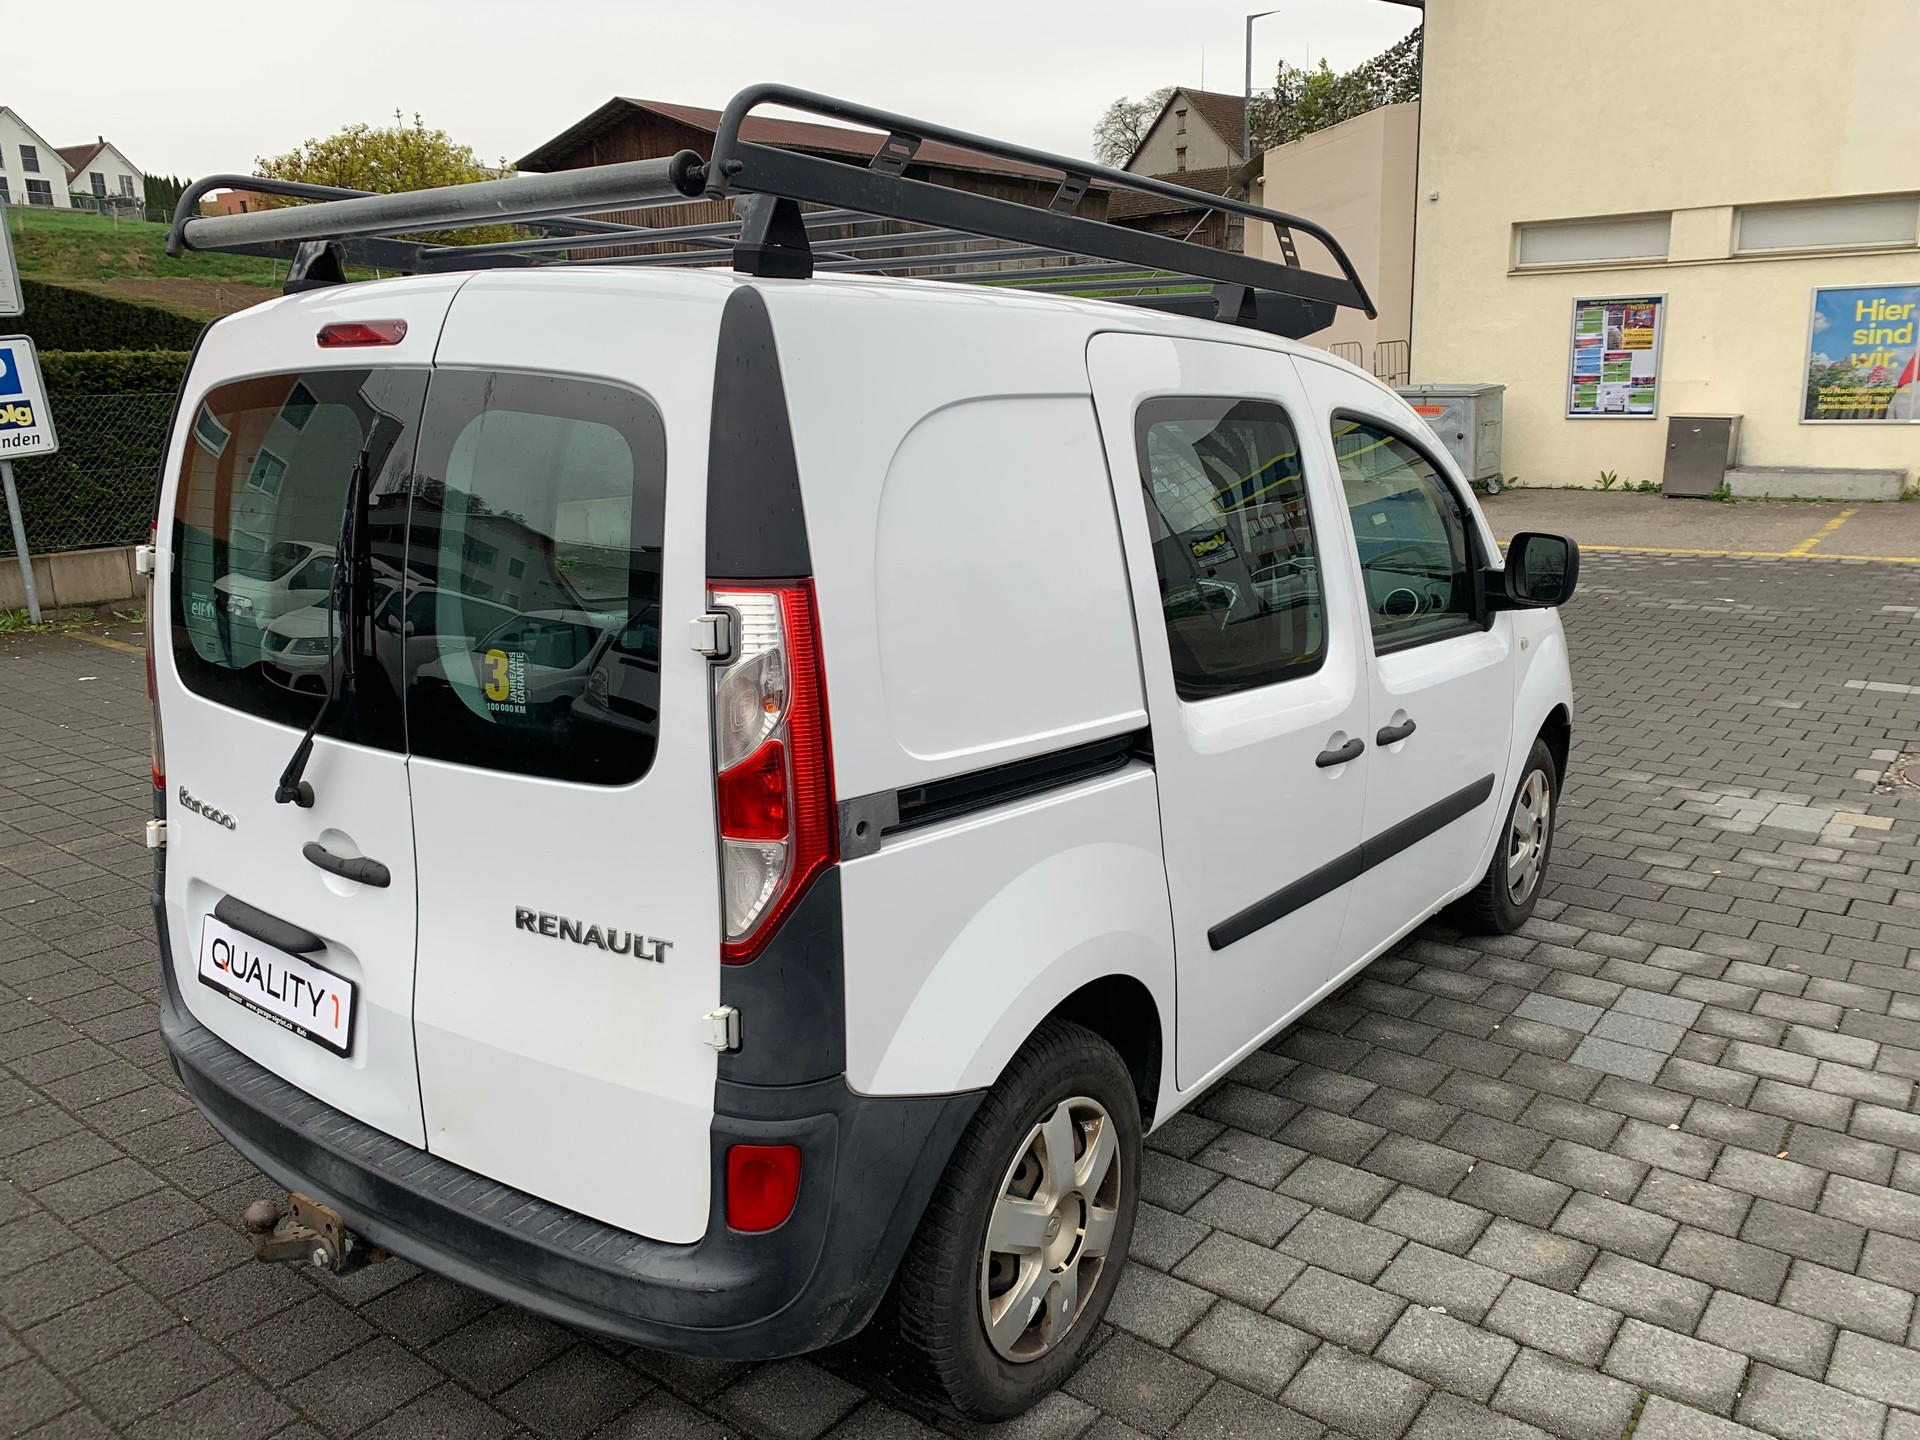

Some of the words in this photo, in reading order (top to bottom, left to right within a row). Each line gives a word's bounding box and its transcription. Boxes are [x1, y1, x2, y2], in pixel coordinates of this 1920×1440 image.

[1856, 298, 1916, 321] Hier
[1852, 322, 1913, 345] sind
[1851, 346, 1898, 368] wir.
[0, 433, 40, 448] nden
[484, 649, 509, 701] 3
[509, 652, 517, 703] JAHRE/ANS
[516, 652, 526, 704] GARANTIE
[514, 705, 526, 714] KM
[515, 905, 673, 963] RENAULT
